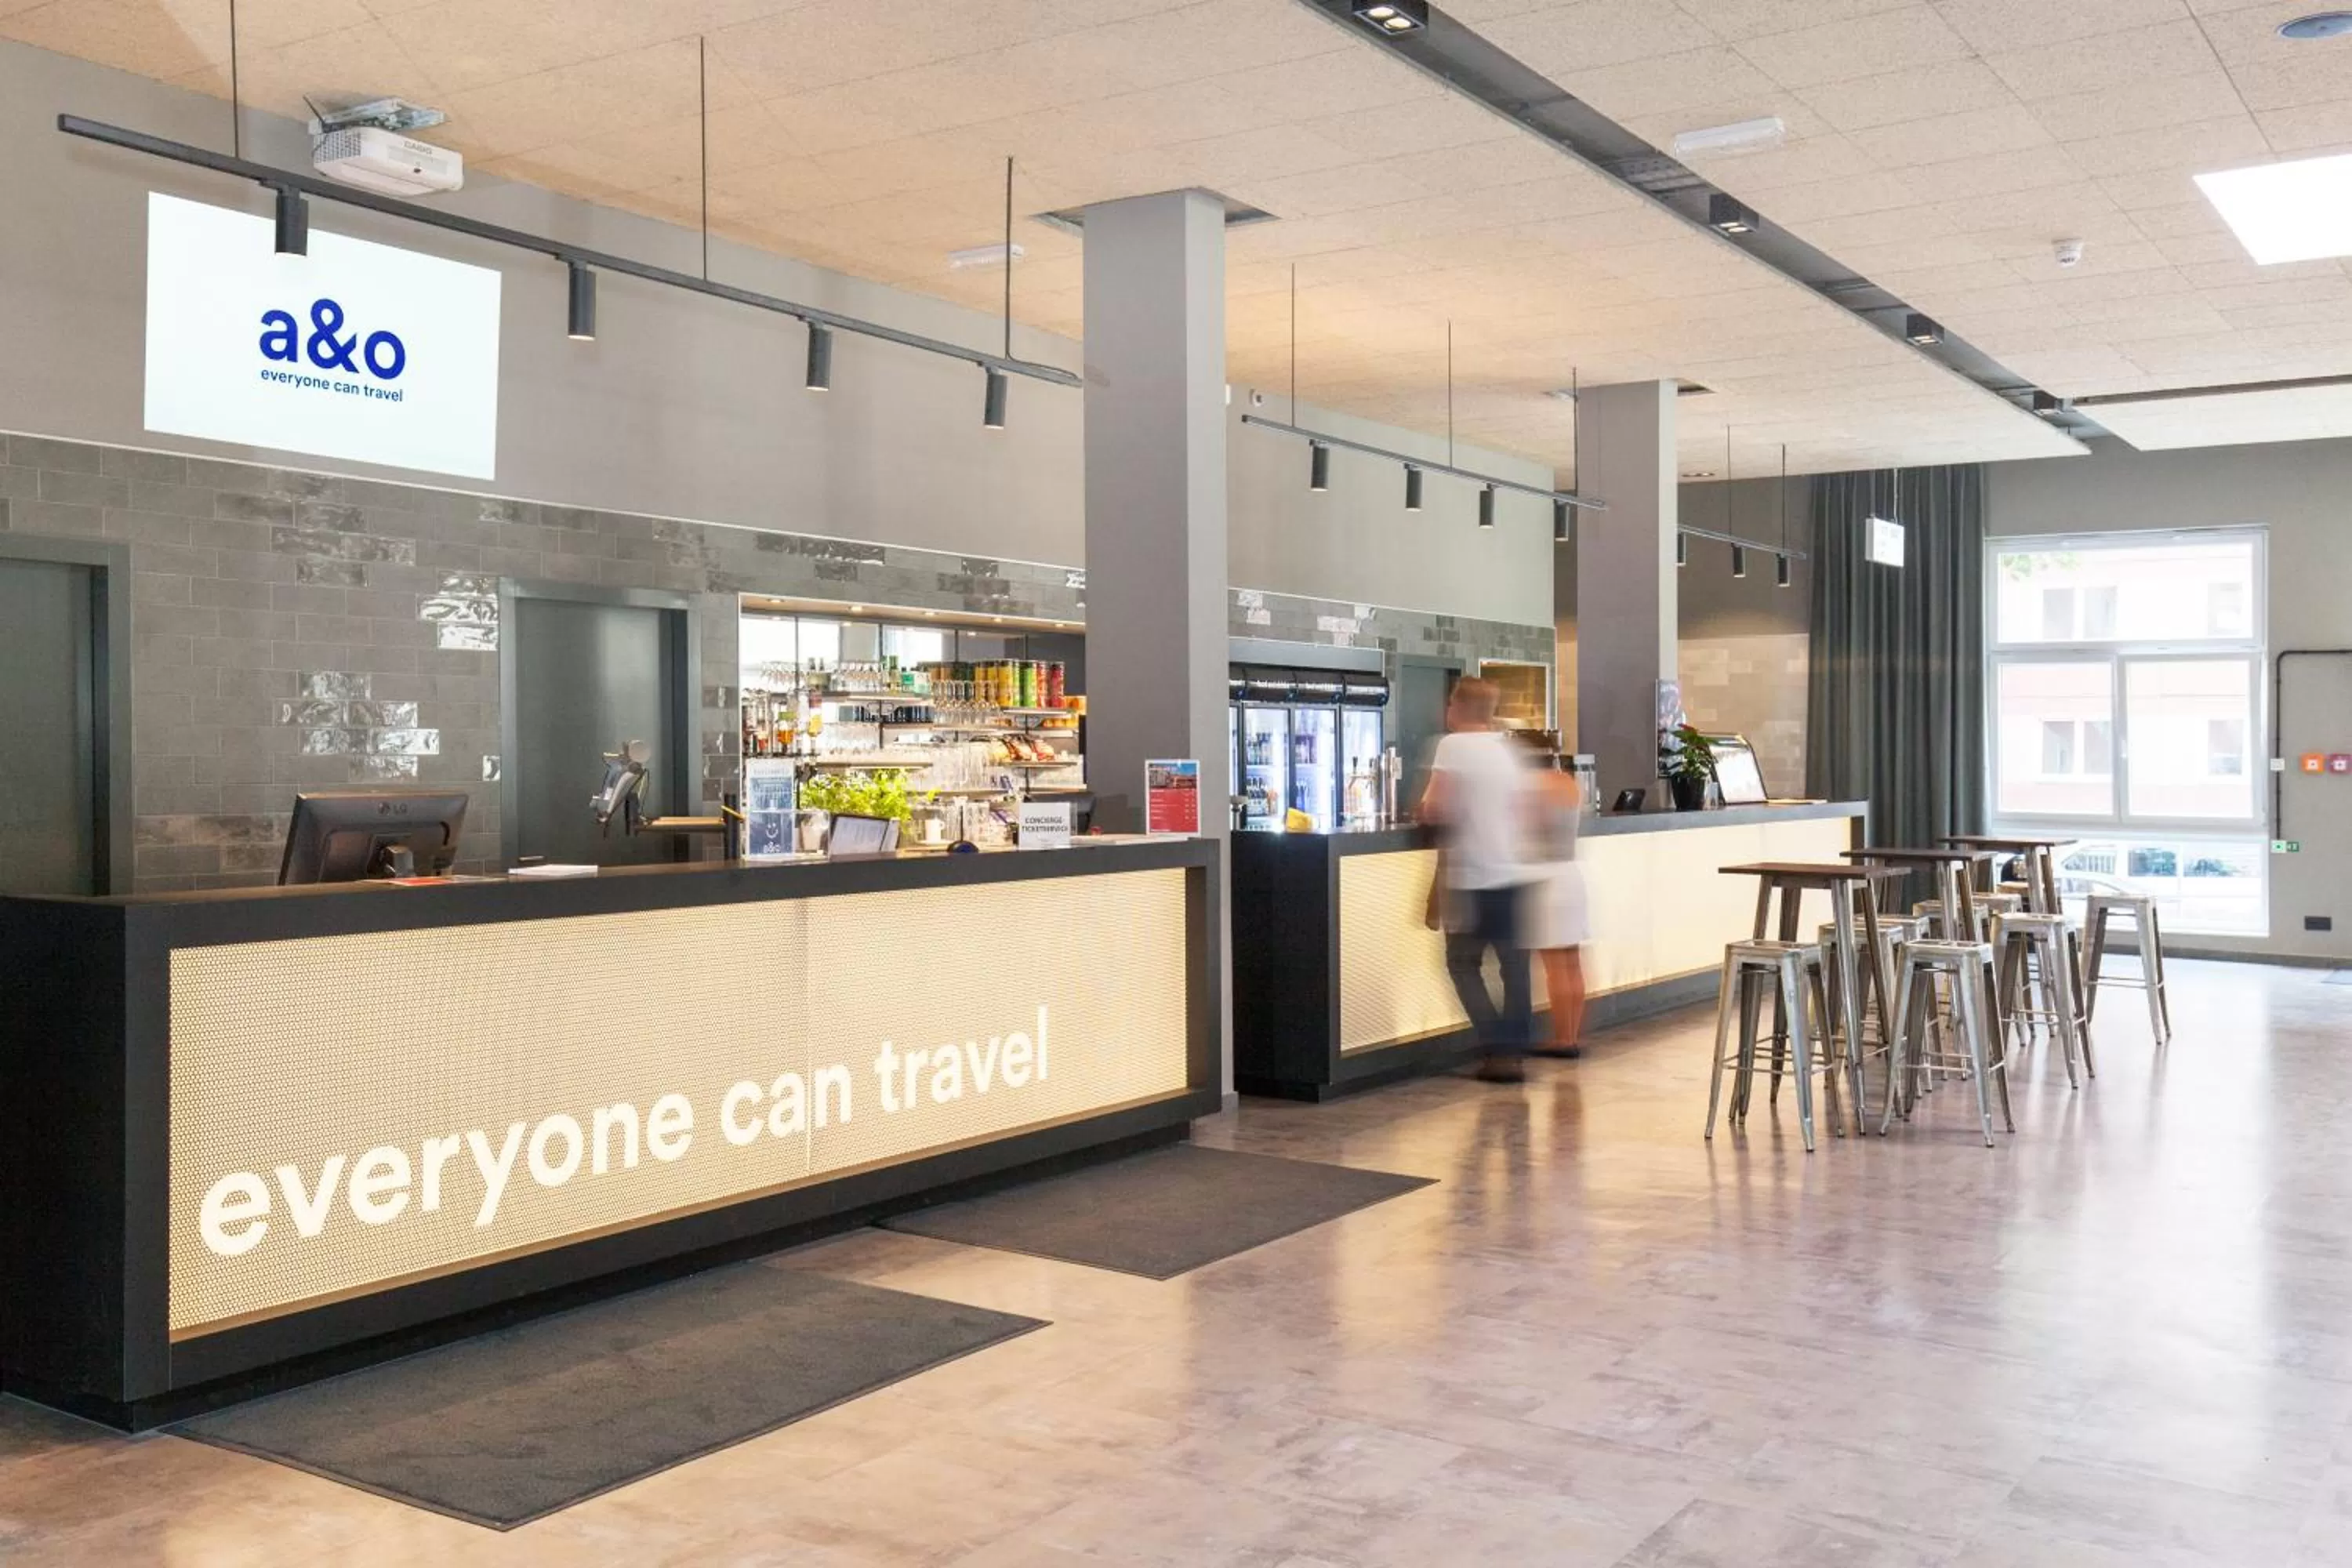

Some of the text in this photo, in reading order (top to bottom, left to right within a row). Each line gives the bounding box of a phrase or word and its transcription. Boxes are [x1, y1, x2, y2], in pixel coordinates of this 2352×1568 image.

[260, 298, 405, 379] a&o
[261, 369, 404, 401] everyone can travel
[394, 803, 408, 814] LG
[199, 1004, 1048, 1256] everyone can travel
